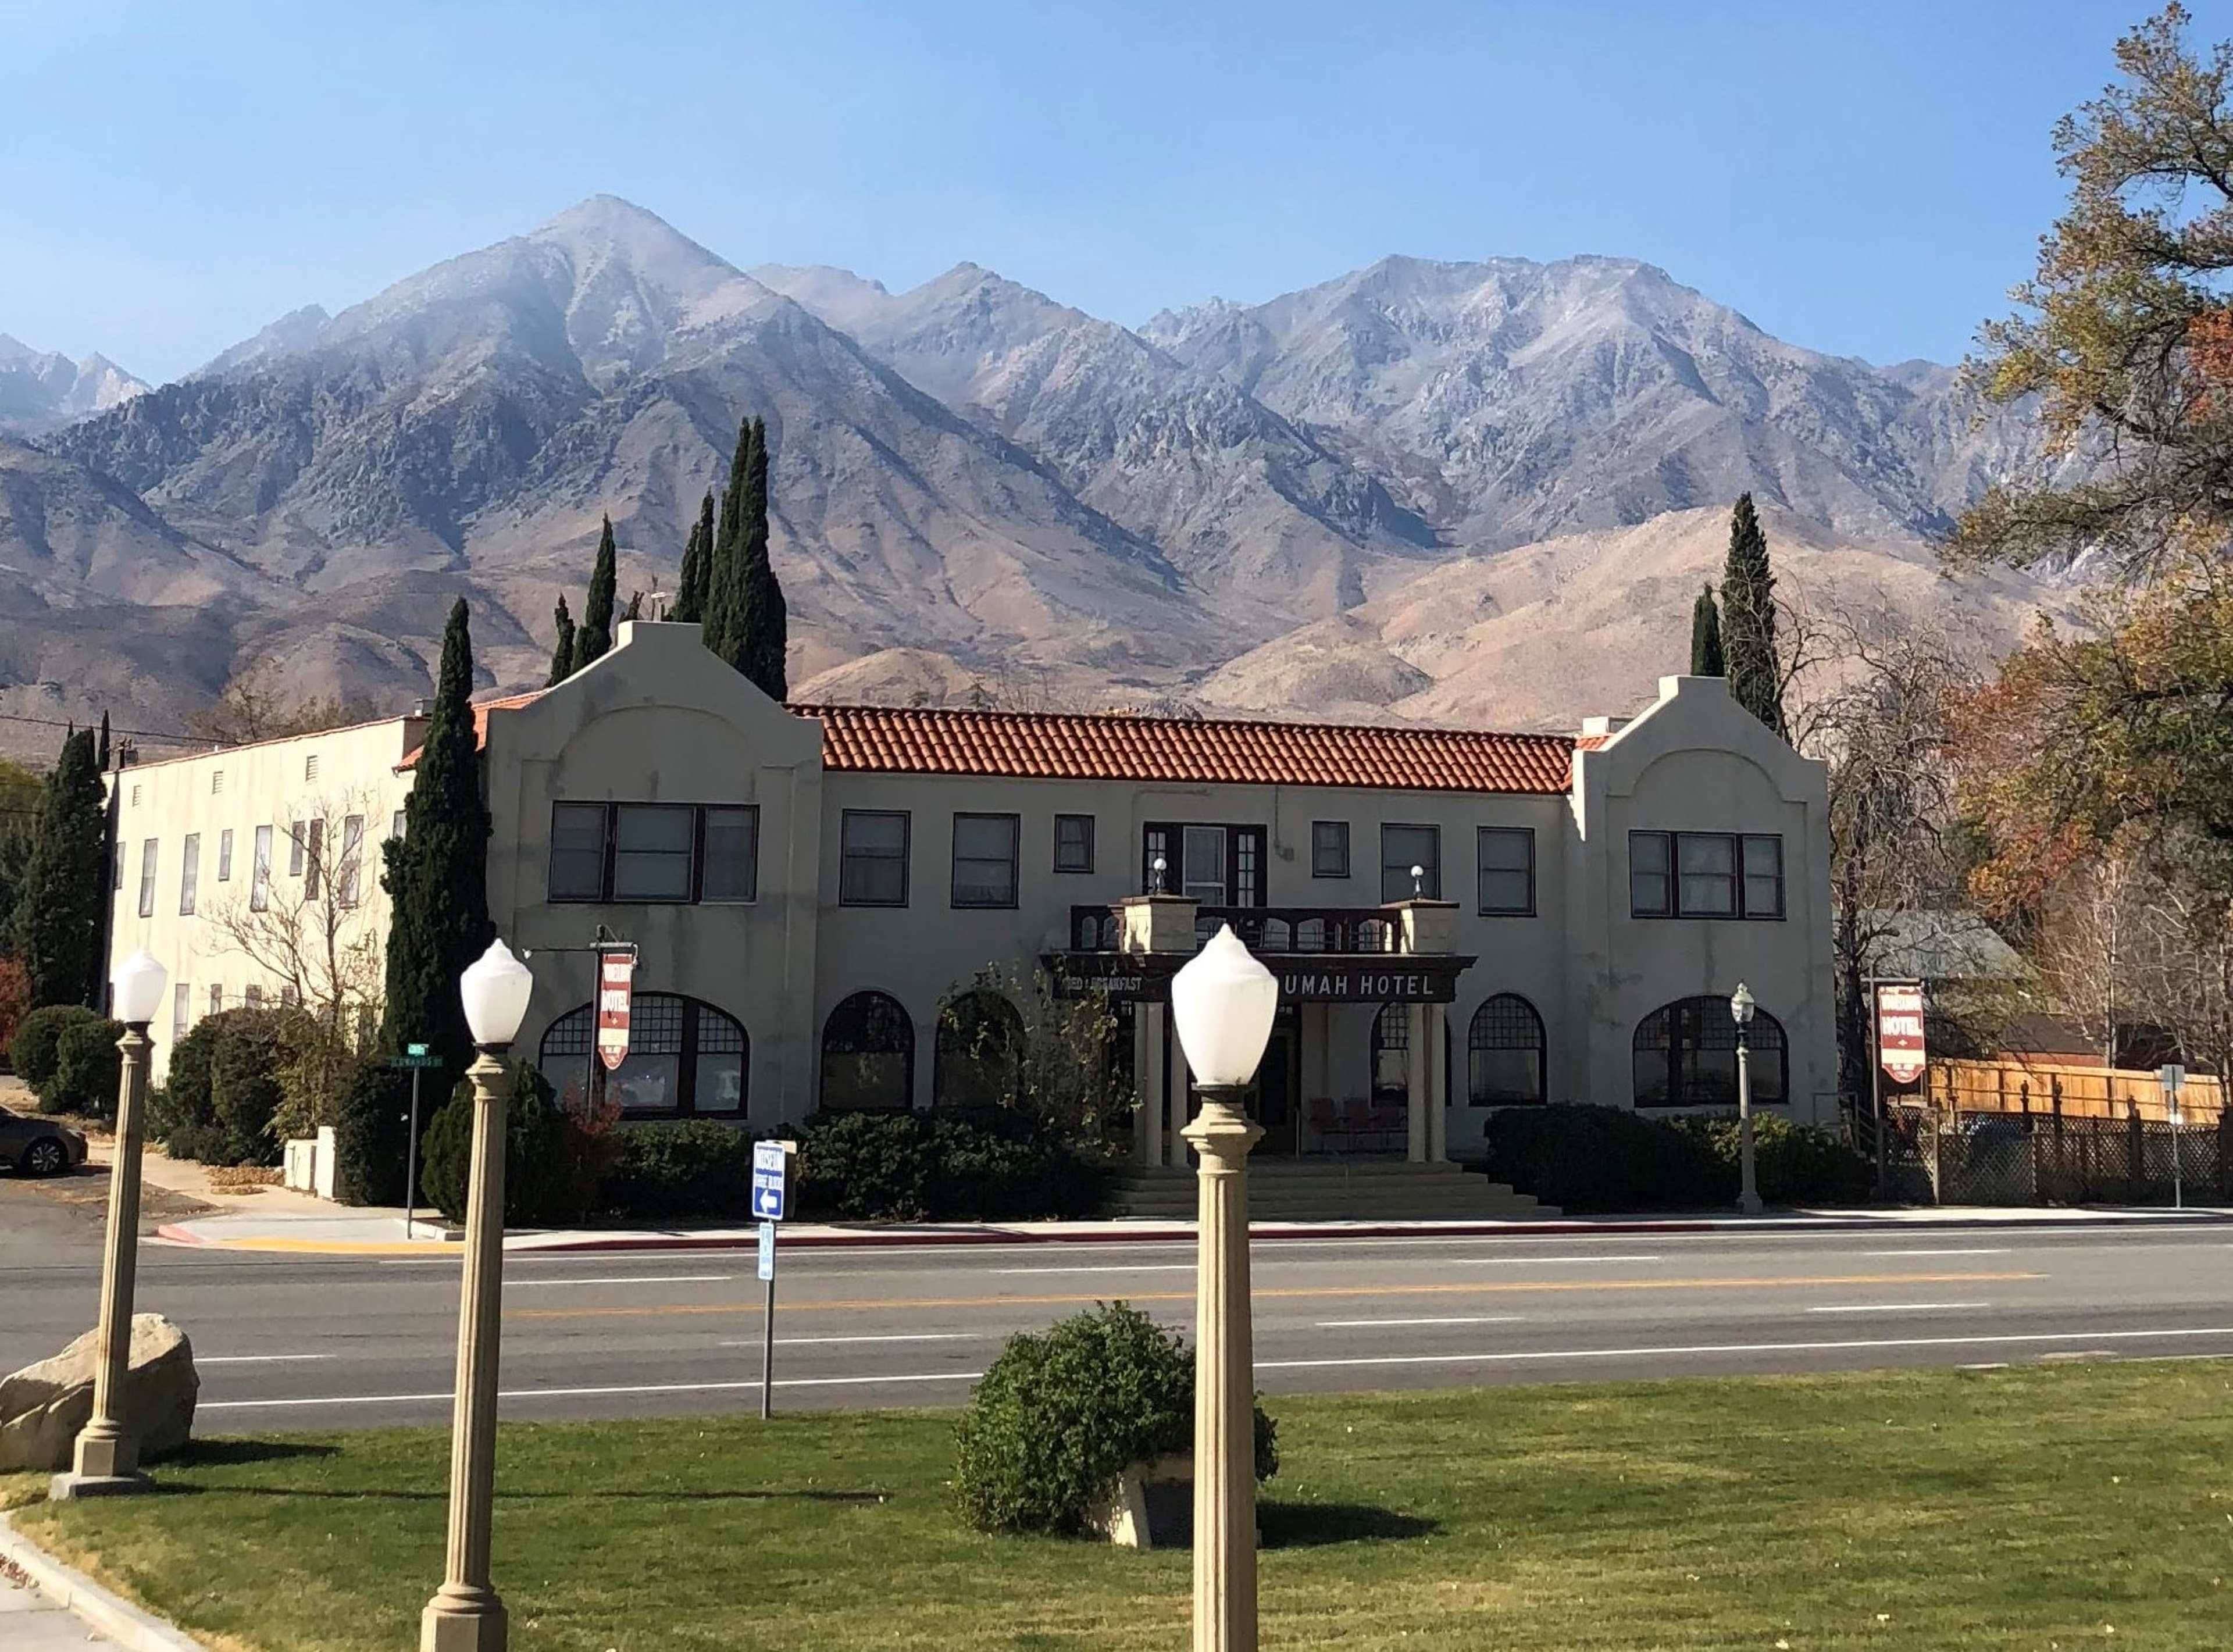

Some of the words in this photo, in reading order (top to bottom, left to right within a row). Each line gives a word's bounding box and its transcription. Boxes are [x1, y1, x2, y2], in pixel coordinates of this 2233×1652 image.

[1285, 975, 1347, 995] UMAH
[1360, 975, 1433, 995] HOTEL
[1882, 1016, 1922, 1036] HOTEL
